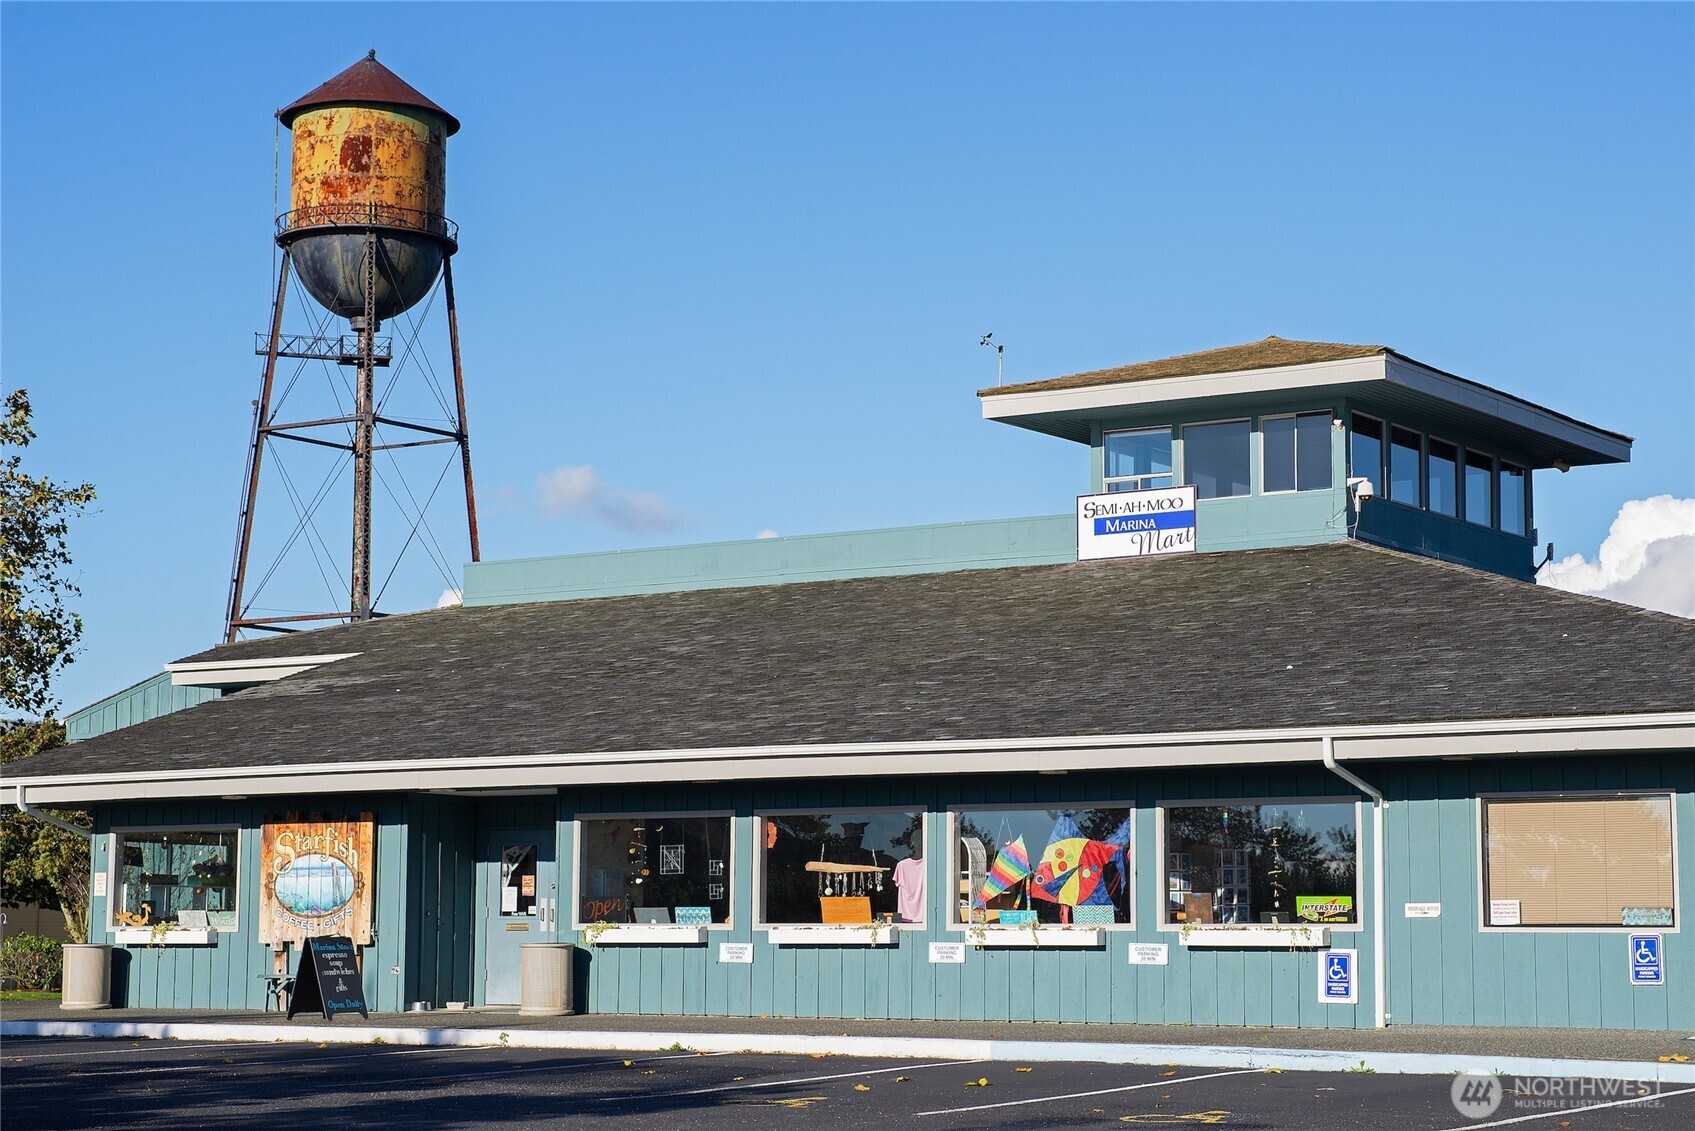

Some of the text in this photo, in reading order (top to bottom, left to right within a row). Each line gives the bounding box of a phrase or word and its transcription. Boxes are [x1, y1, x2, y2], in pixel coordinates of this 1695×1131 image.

[1105, 518, 1156, 533] MARINA
[1131, 527, 1196, 556] Mart
[273, 827, 360, 875] Starfish
[583, 898, 624, 922] Open
[1301, 904, 1348, 912] INTERSTATE
[275, 906, 353, 930] COFFEE GIFTS
[312, 942, 336, 951] Marina
[321, 952, 348, 960] espresso
[327, 1000, 345, 1010] Open
